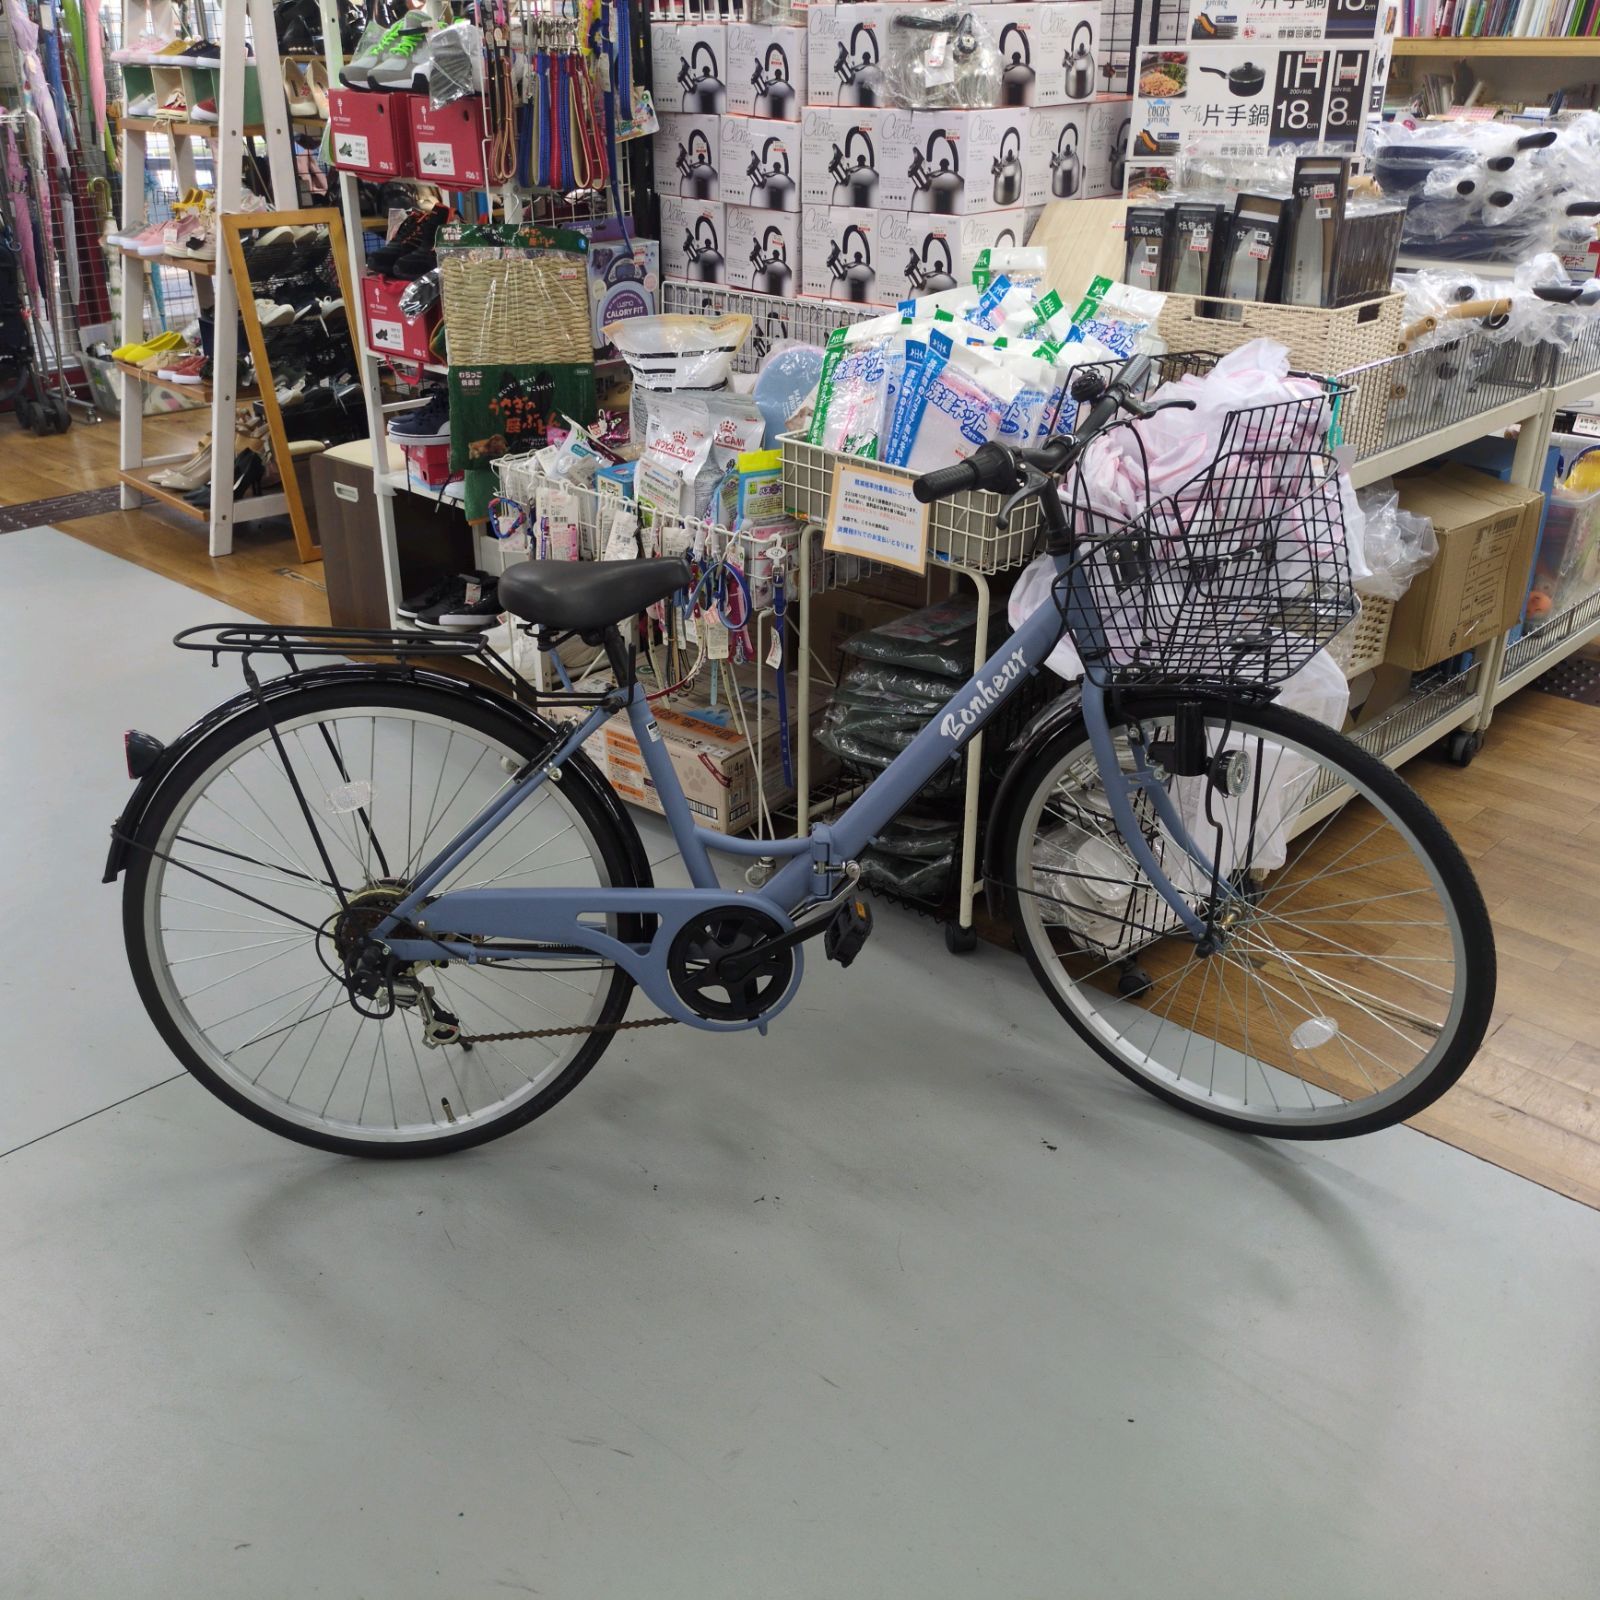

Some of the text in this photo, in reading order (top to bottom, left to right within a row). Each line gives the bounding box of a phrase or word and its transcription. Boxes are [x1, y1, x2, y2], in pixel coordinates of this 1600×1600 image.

[1283, 54, 1323, 88] IH
[1334, 53, 1363, 86] H
[1203, 104, 1270, 127] 片手鍋
[1277, 100, 1319, 129] 18cm
[606, 306, 644, 319] CALORY FIT
[458, 371, 483, 379] わらっこ
[926, 379, 989, 433] 洗濯ネット
[940, 646, 1027, 740] Bonheur
